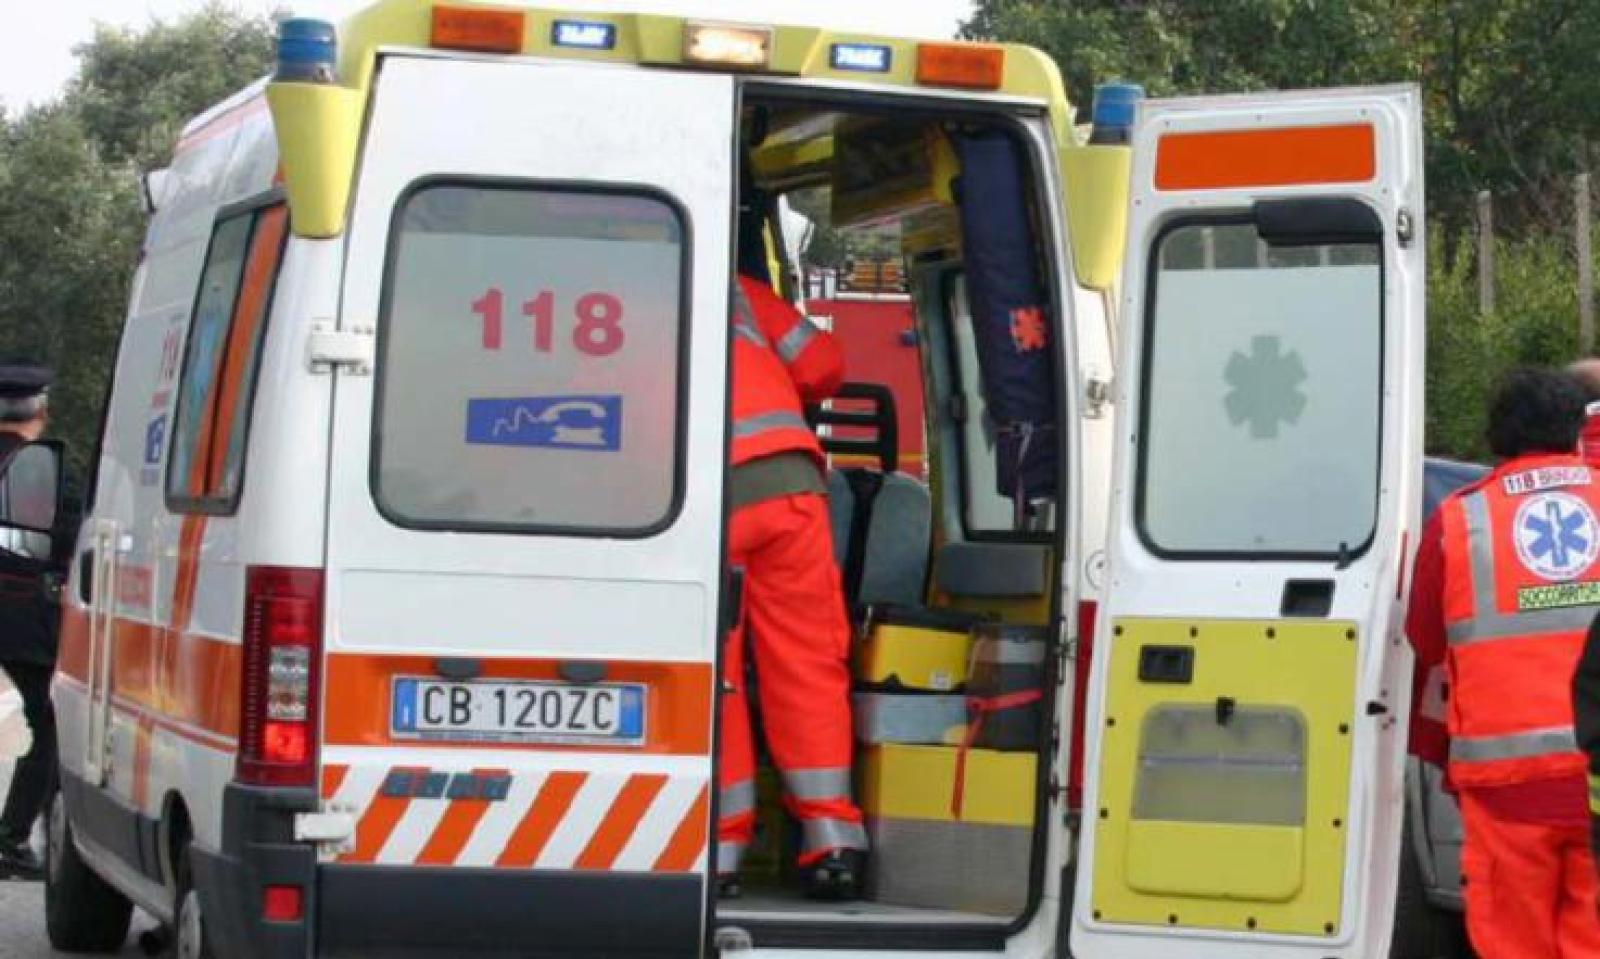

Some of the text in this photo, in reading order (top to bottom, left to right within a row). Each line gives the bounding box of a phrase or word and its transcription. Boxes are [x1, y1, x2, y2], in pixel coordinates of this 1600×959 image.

[471, 288, 625, 356] 118
[422, 685, 613, 731] CB 120ZC
